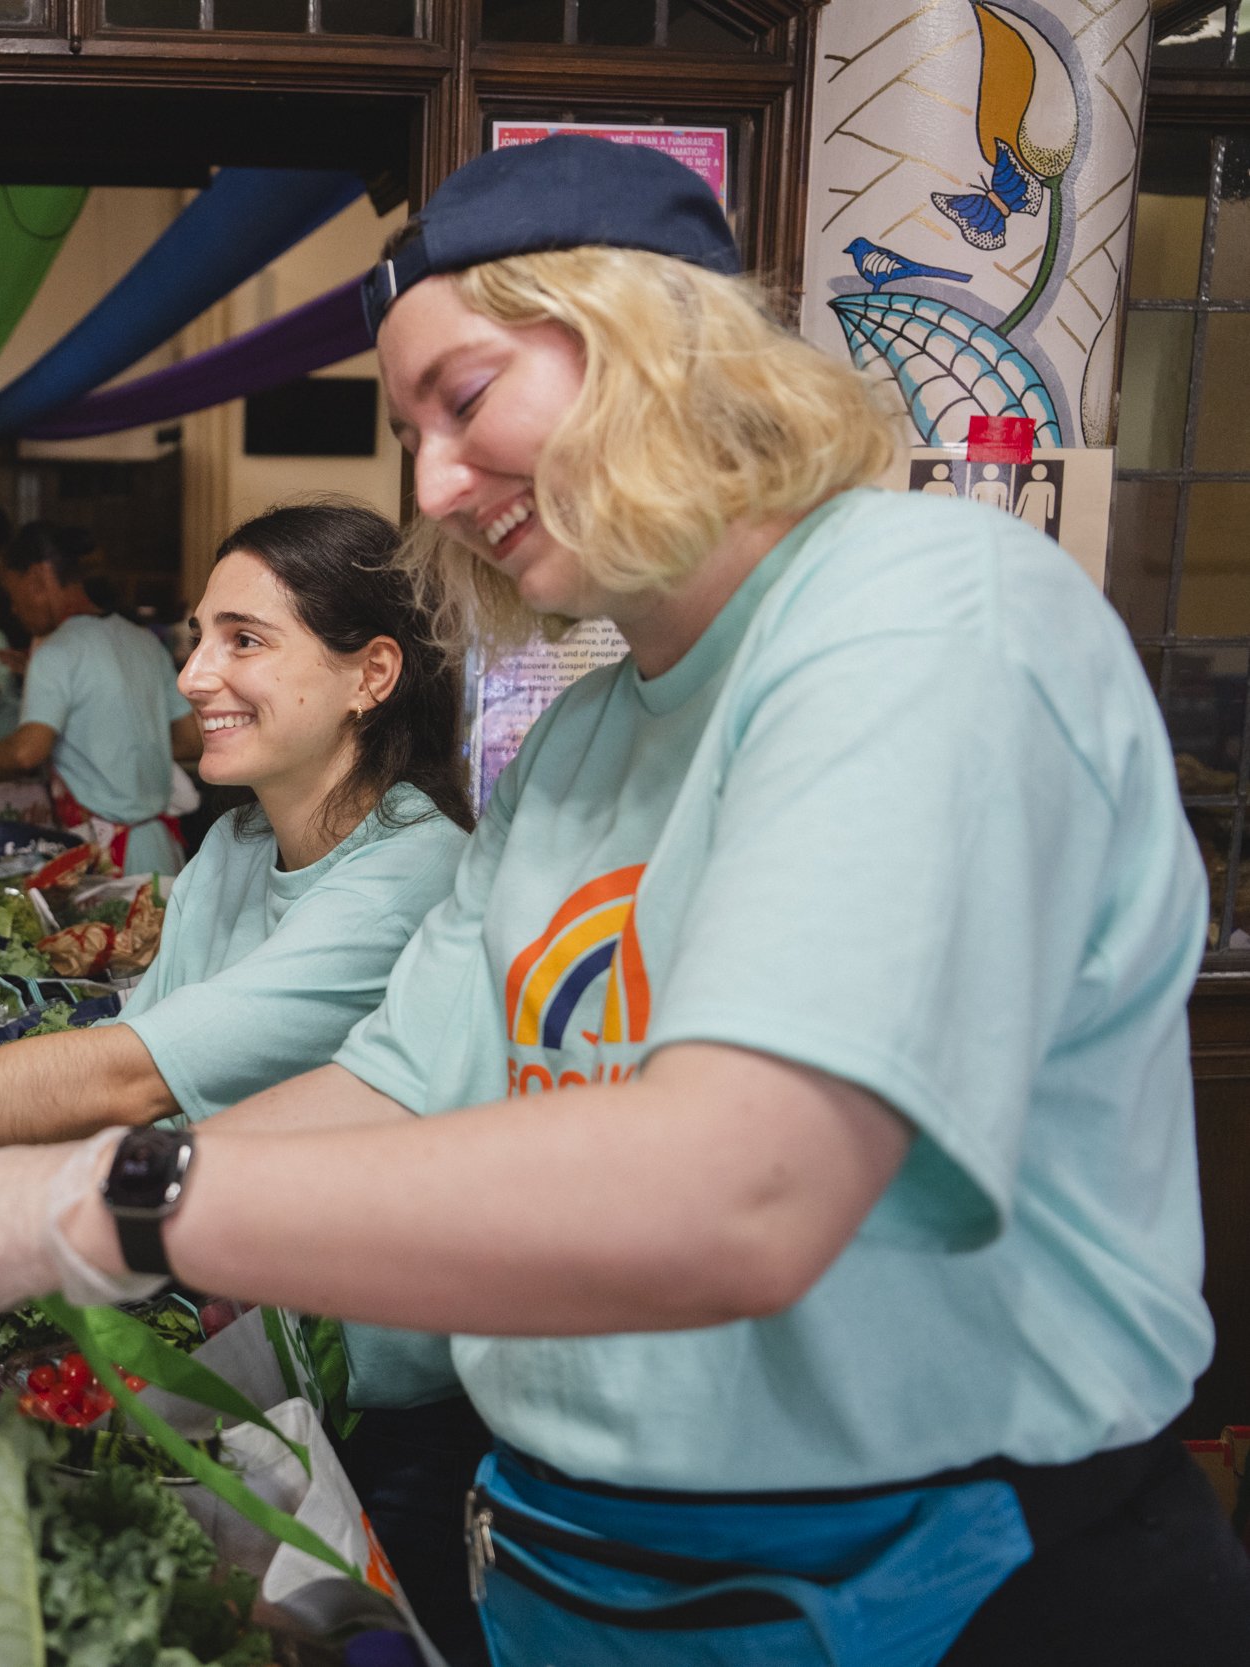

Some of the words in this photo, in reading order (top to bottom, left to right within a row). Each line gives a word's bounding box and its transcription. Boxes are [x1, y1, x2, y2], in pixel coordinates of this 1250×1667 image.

[611, 136, 633, 144] MORE
[637, 136, 657, 145] THAN
[660, 136, 666, 145] A
[668, 136, 716, 147] FUNDRAISER,
[695, 158, 711, 167] NOT
[714, 158, 720, 167] A
[590, 650, 617, 659] people
[558, 662, 587, 671] Gospel
